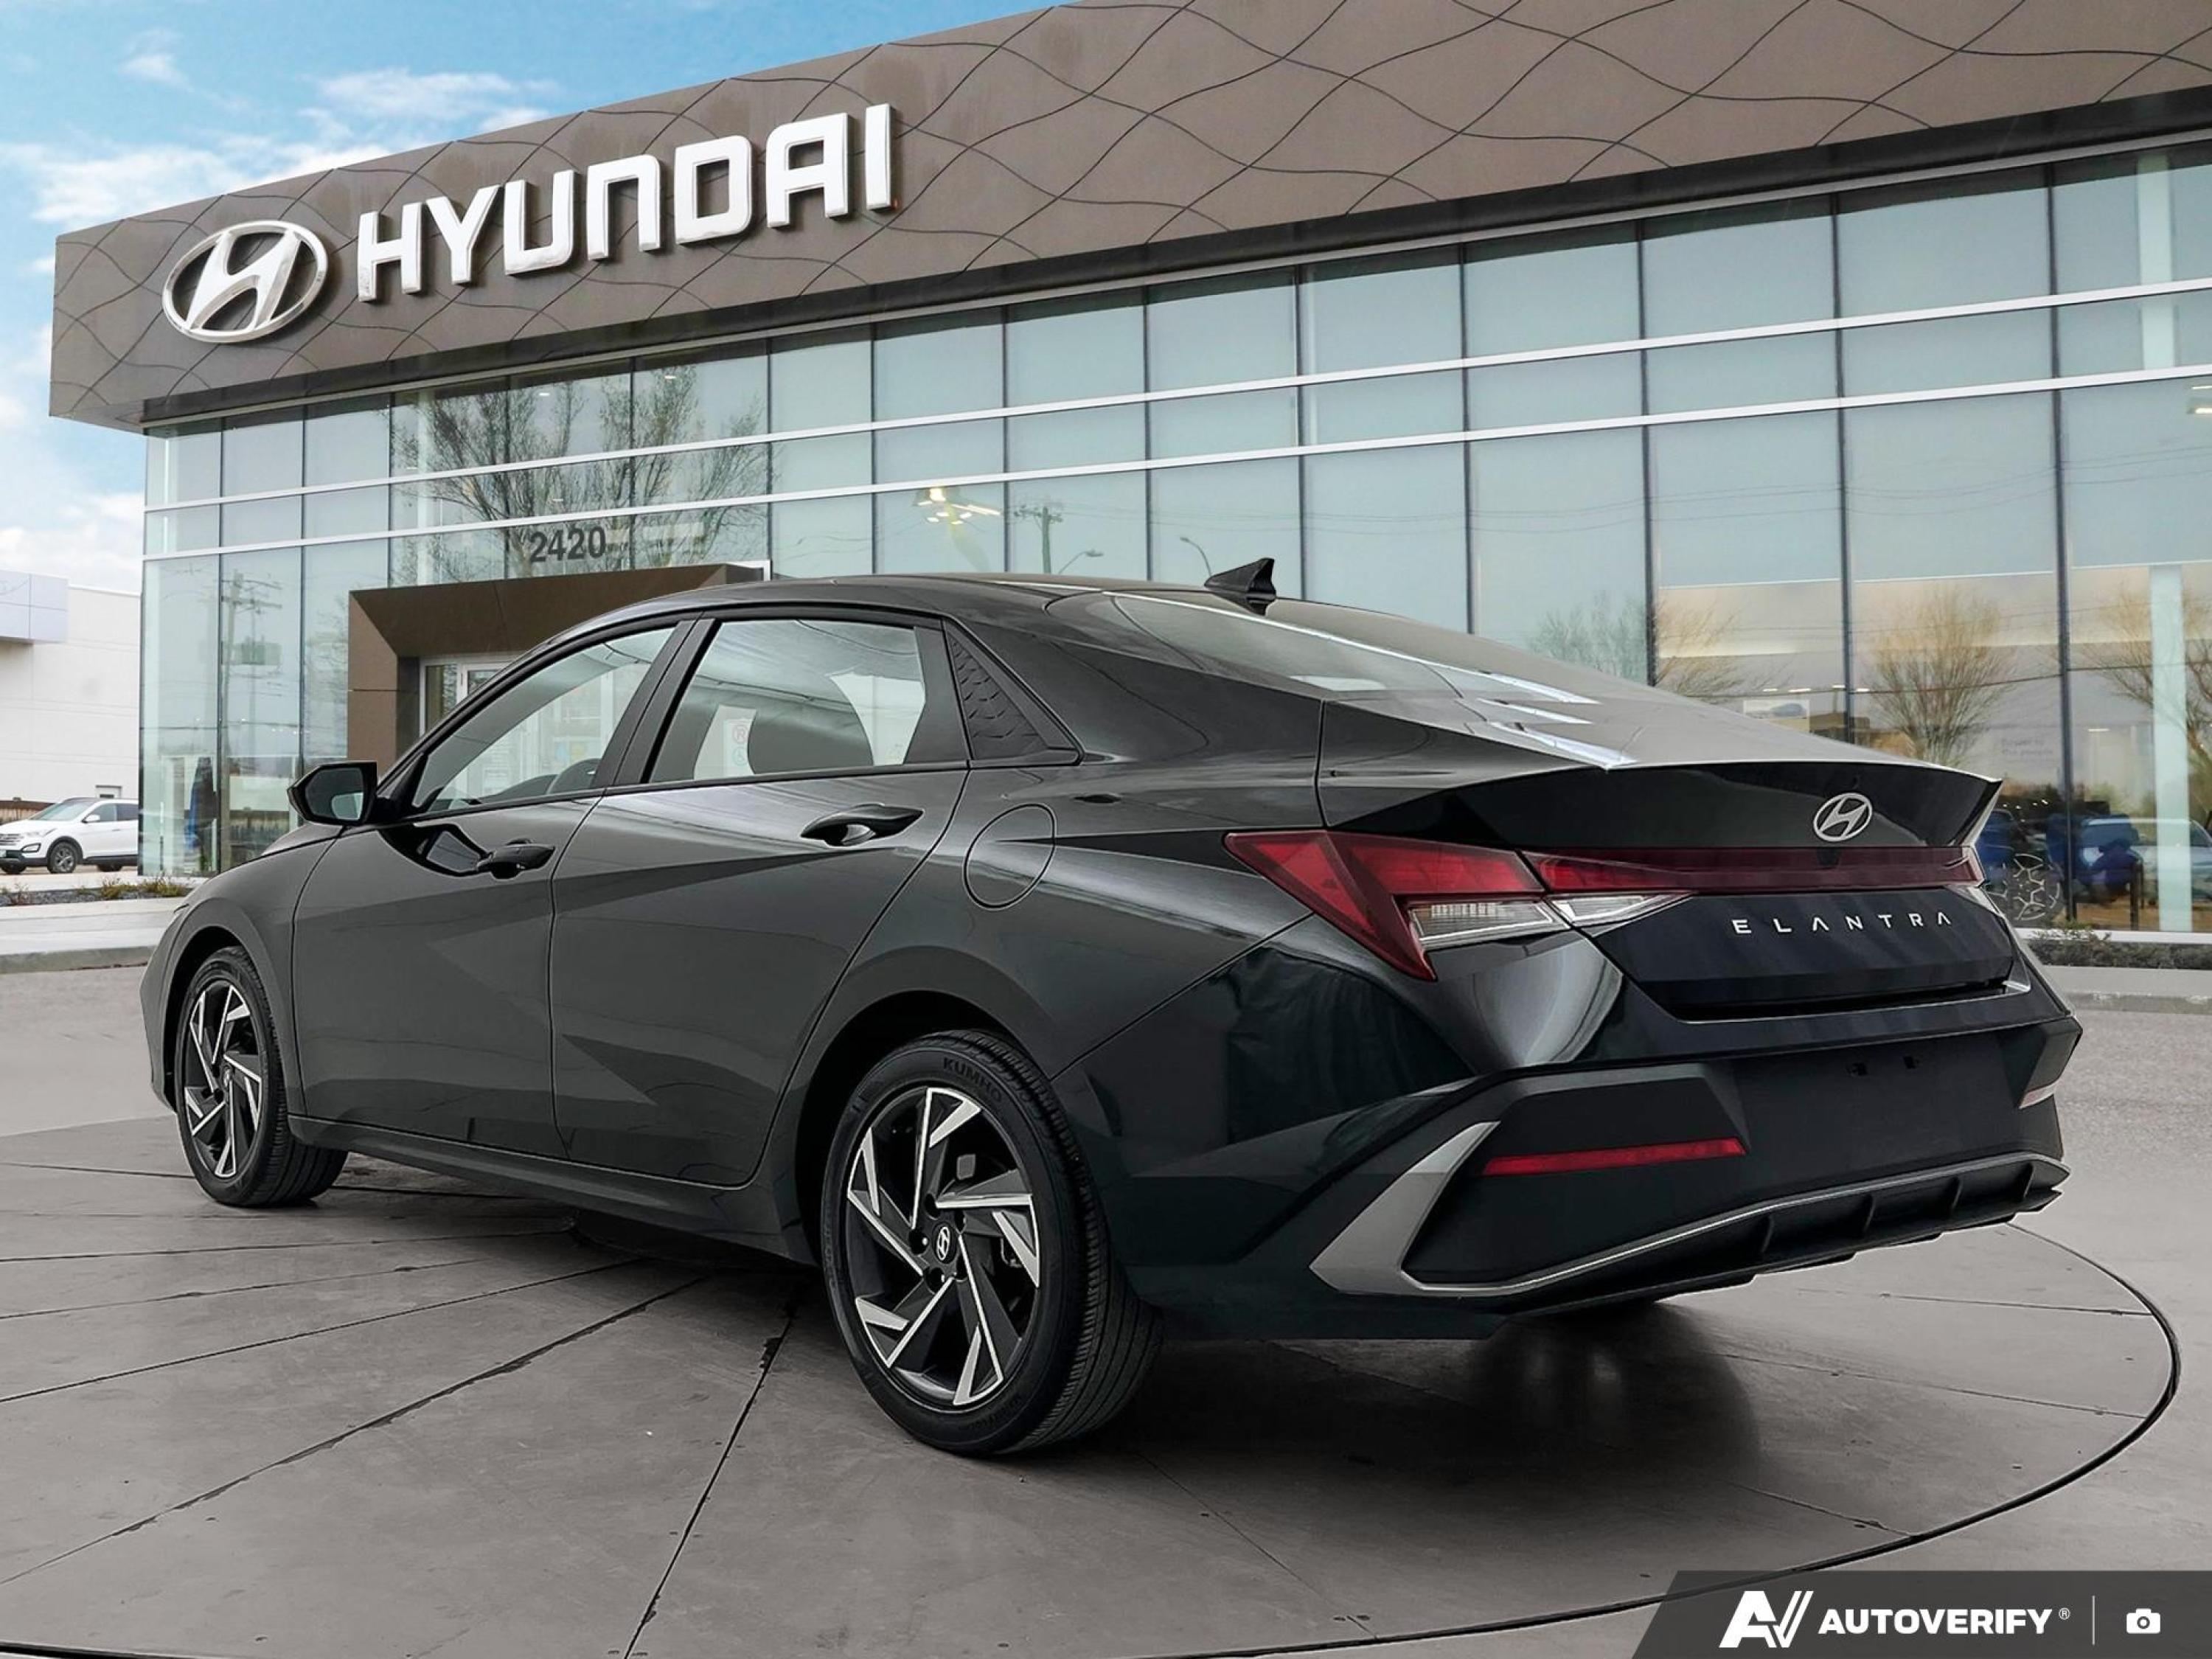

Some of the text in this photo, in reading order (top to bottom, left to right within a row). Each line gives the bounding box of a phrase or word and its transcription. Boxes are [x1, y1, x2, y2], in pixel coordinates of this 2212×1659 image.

[357, 103, 893, 302] HYUNDAI
[528, 526, 606, 563] 2420
[1733, 911, 1951, 934] ELANTRA
[943, 1057, 1003, 1102] KUMHO
